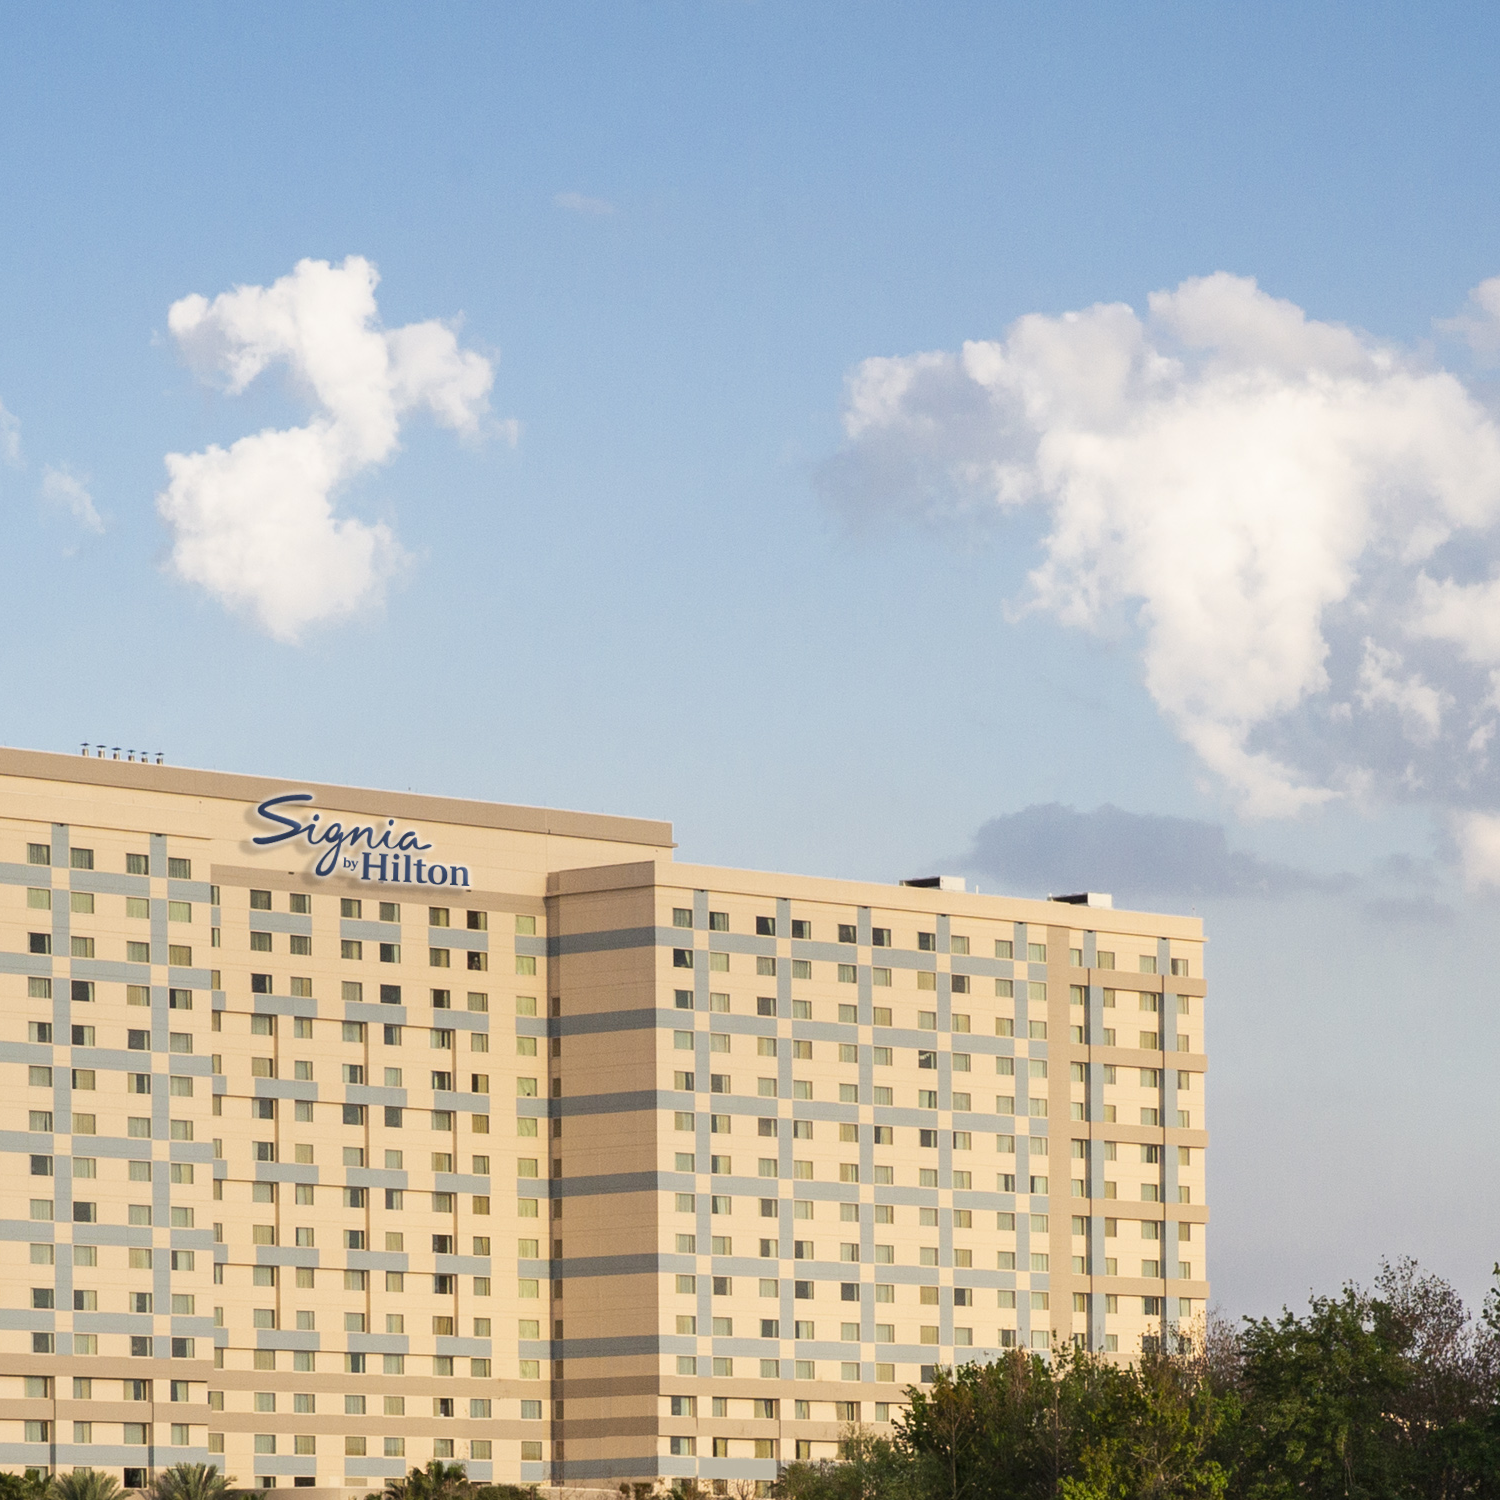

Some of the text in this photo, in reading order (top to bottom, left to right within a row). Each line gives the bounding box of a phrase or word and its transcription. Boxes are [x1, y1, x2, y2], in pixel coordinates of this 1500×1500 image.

[252, 794, 432, 877] Signia
[343, 852, 470, 887] by Hilton
